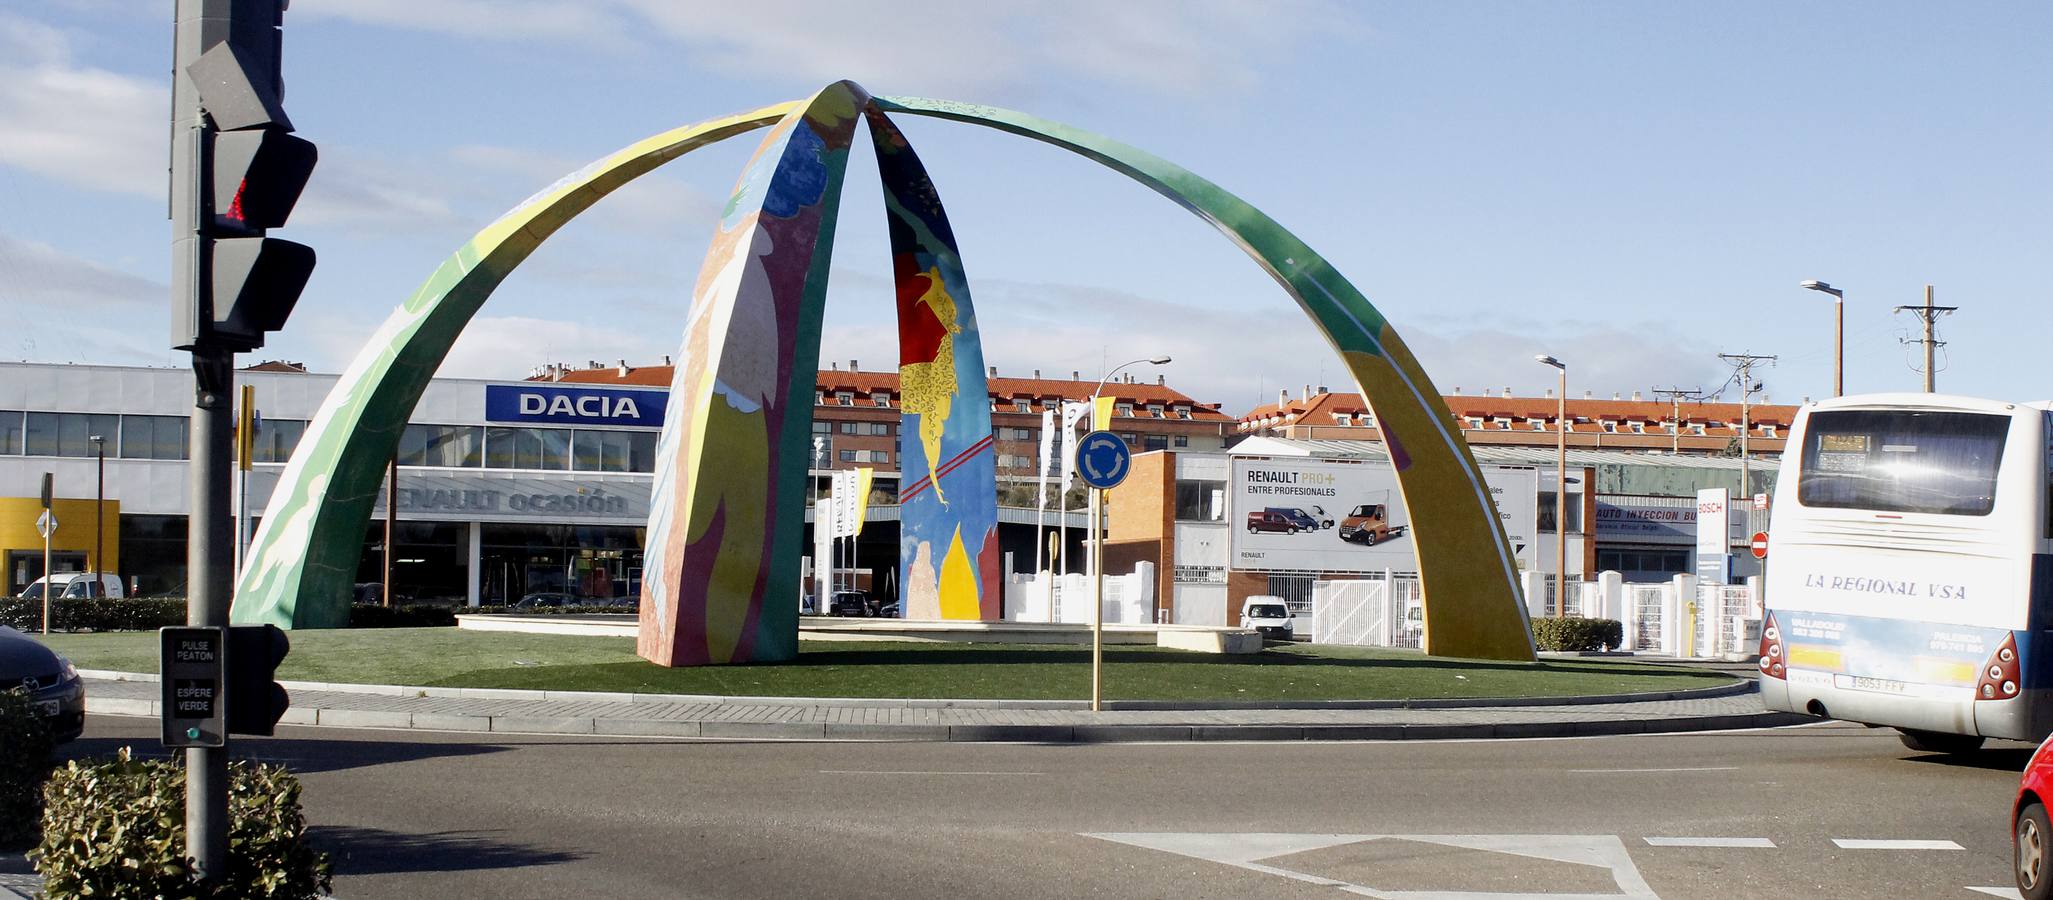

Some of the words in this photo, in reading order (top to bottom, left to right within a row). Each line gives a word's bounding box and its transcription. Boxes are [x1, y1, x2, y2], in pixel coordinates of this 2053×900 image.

[519, 393, 641, 419] DACIA
[1247, 470, 1299, 484] RENAULT
[1301, 472, 1336, 485] PRO+
[1247, 485, 1273, 495] ENTRE
[1274, 487, 1336, 497] PROFESIONALES
[381, 486, 501, 512] ENAULT
[508, 488, 629, 514] ocasión
[1596, 508, 1621, 519] AUTO
[1626, 509, 1679, 521] INYECCION
[1683, 512, 1698, 521] BU
[1698, 503, 1723, 514] BOSCH
[1240, 551, 1266, 559] RENAULT
[1805, 573, 1825, 588] LA
[1831, 576, 1918, 597] REGIONAL
[1934, 631, 1982, 644] PALENCIA
[181, 641, 209, 650] PULSE
[177, 651, 213, 660] PEATON
[1856, 677, 1882, 690] 9053
[177, 688, 212, 697] ESPERE
[178, 701, 209, 710] VERDE
